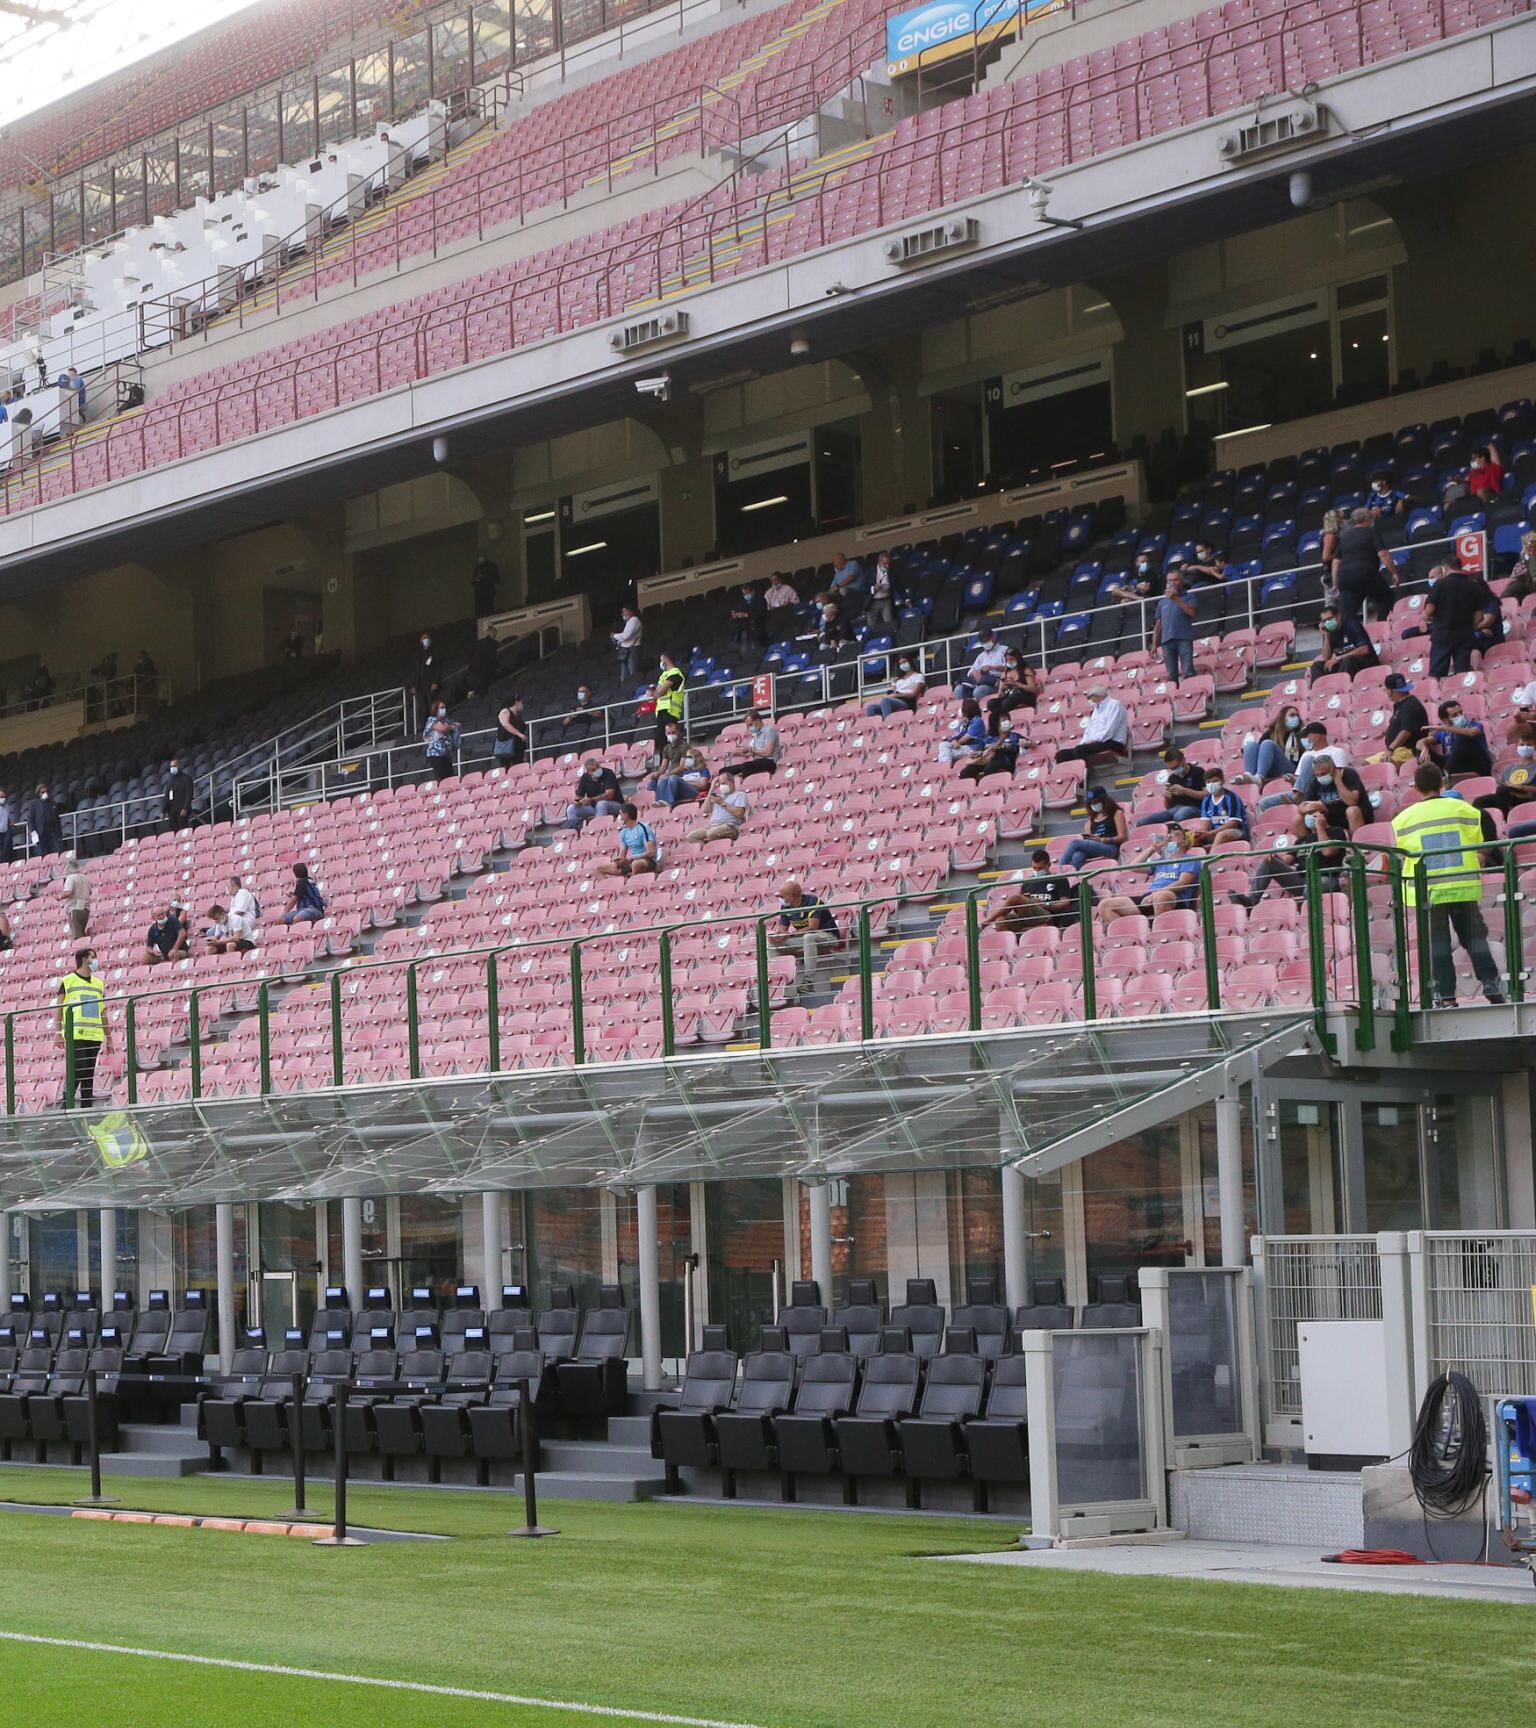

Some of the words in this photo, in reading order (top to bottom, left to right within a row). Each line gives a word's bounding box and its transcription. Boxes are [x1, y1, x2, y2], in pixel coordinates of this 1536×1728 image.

[1187, 333, 1198, 347] 11
[986, 387, 1000, 402] 10
[1461, 536, 1479, 557] G
[756, 677, 766, 694] F
